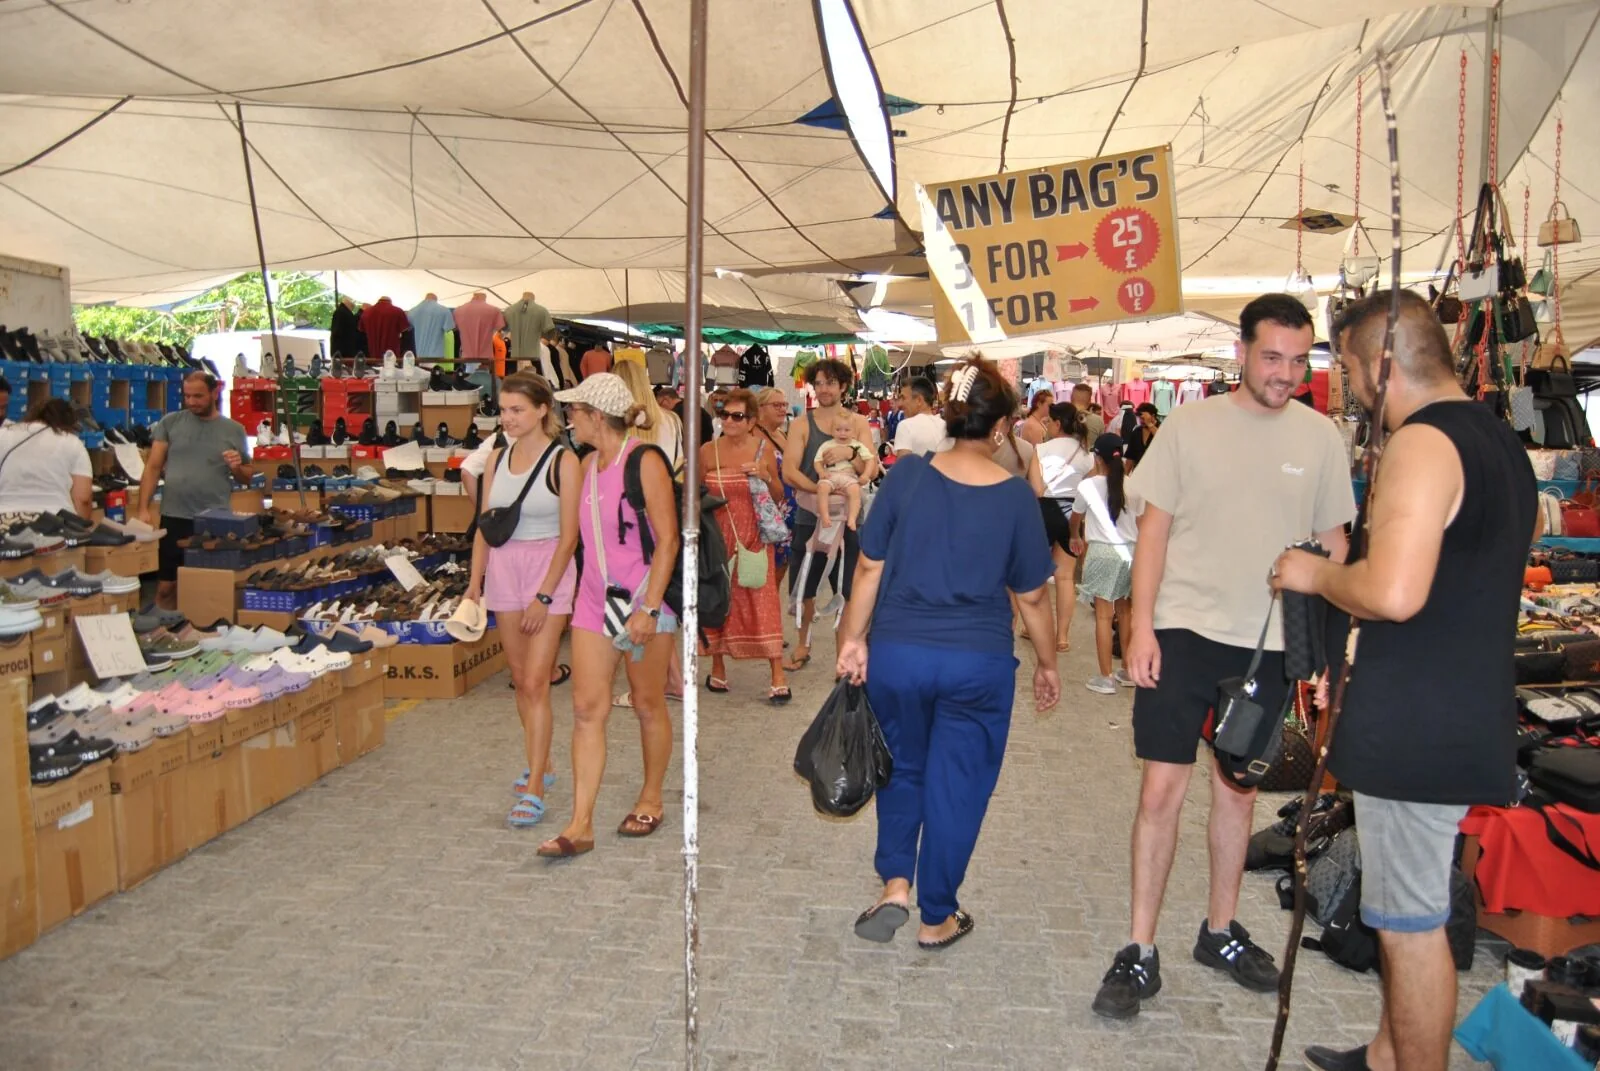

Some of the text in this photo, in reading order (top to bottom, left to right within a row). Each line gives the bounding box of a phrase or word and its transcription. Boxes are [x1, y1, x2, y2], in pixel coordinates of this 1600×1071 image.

[935, 154, 1159, 232] ANY BAG'S
[949, 214, 1143, 290] 3 FOR 25
[1124, 250, 1137, 269] £
[960, 282, 1145, 332] 1 FOR 10
[1133, 298, 1143, 312] £
[0, 658, 29, 676] crocs
[386, 665, 439, 680] B.K.S.
[189, 711, 213, 720] rocs
[36, 766, 70, 780] crocs
